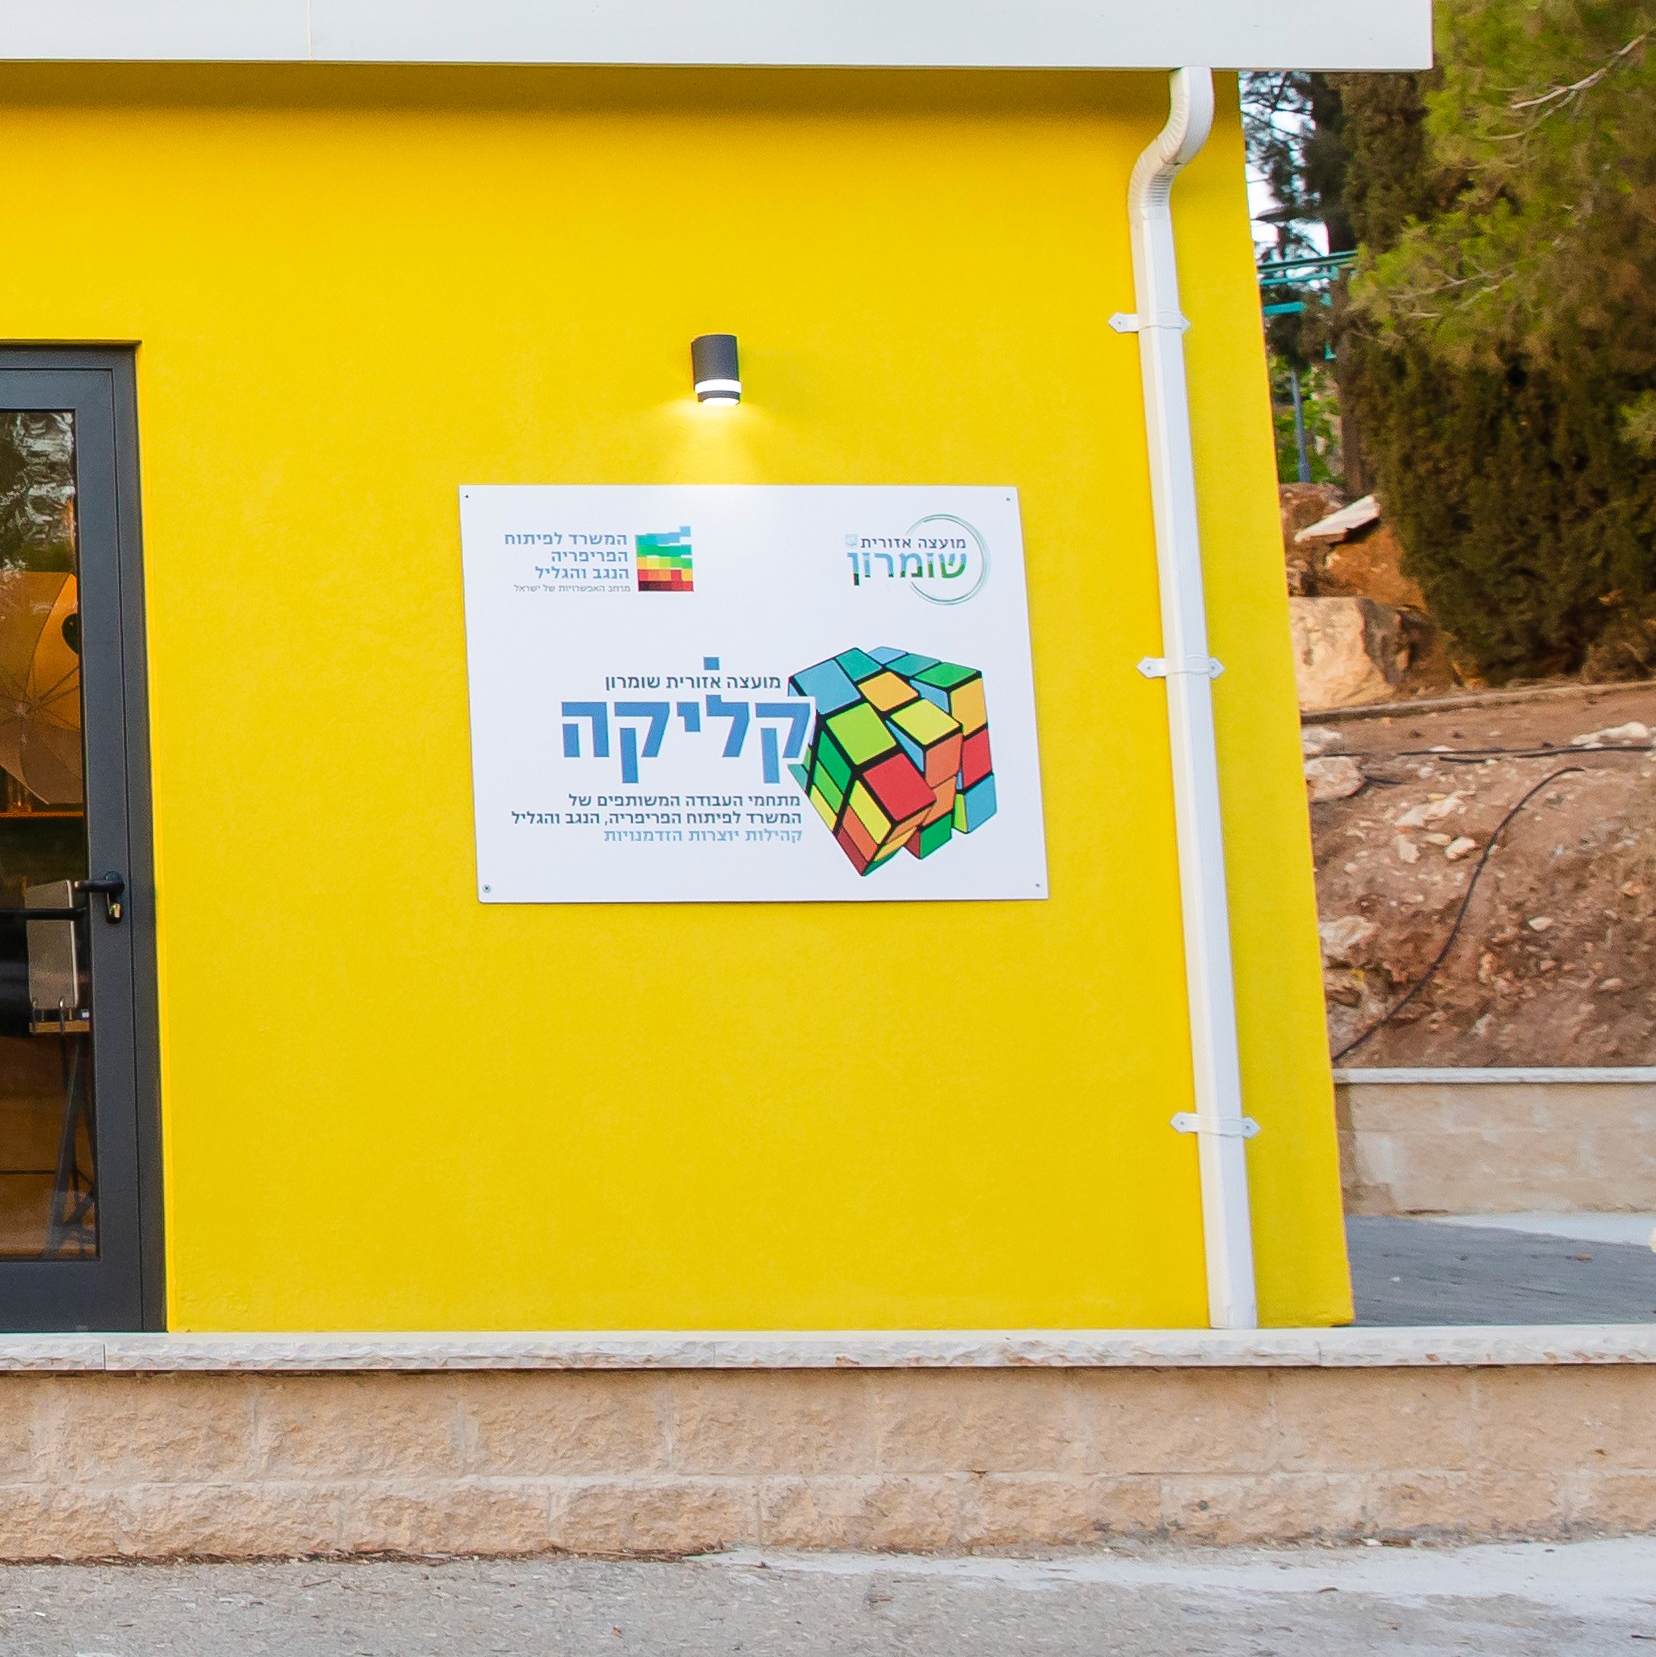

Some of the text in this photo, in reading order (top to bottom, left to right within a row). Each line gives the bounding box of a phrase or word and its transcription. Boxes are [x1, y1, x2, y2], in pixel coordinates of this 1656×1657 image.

[504, 531, 628, 546] המשרד לפיתוח
[860, 537, 966, 549] מועצה אזורית
[551, 550, 629, 563] הפריפריה
[535, 565, 630, 580] הנגב והגליל
[847, 552, 968, 586] שומרון
[605, 675, 782, 691] מועצה אזורית שומרון
[561, 656, 811, 784] קליקה
[568, 793, 801, 807] מתחמי העבודה המשותפים של
[511, 810, 803, 826] המשרד לפיתוח הפריפריה, הנגב והגליל
[603, 828, 803, 844] קהילות יוצרות הזדמנויות
